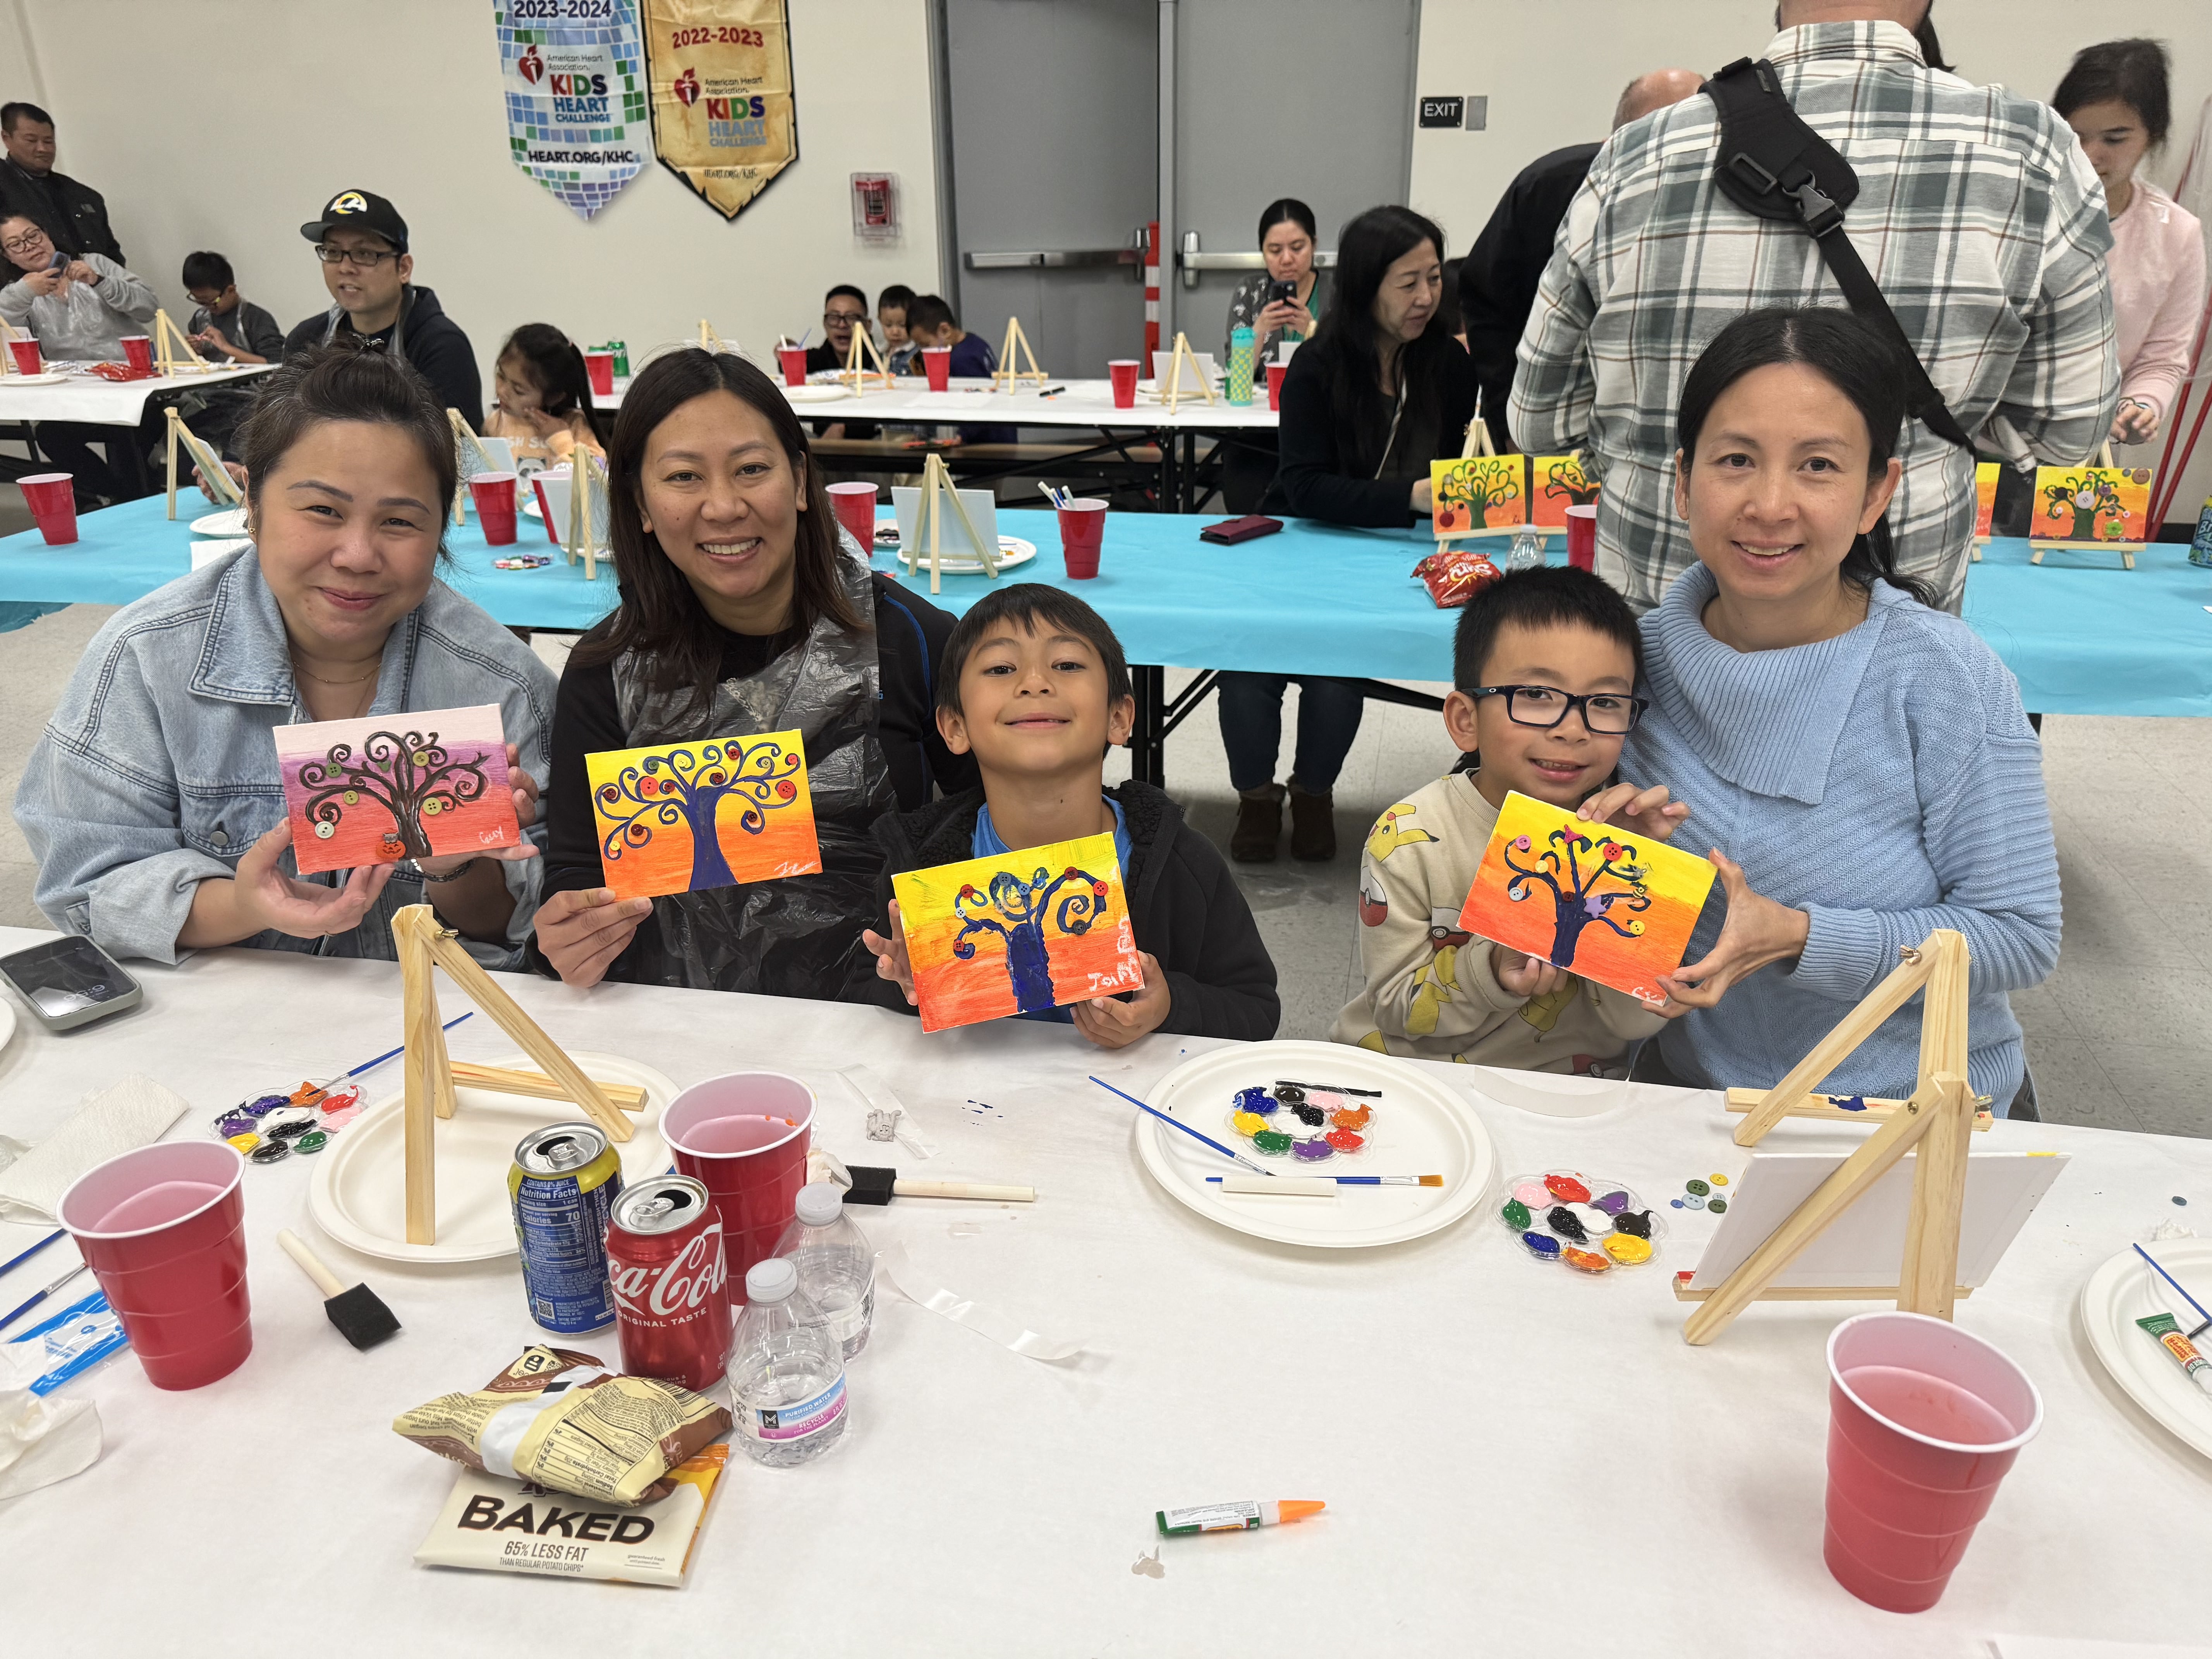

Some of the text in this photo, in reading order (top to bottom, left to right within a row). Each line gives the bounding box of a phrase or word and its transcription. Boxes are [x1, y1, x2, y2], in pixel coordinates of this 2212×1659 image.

[514, 0, 611, 18] 2023-2024
[673, 27, 764, 49] 2022-2023
[547, 54, 580, 62] American
[550, 74, 608, 96] KIDS
[705, 76, 763, 86] American Heart
[553, 97, 609, 112] HEART
[706, 96, 765, 120] KIDS
[1424, 102, 1459, 117] EXIT
[555, 113, 611, 123] CHALLENGE
[708, 119, 765, 137] HEART
[709, 136, 767, 148] CHALLENGE
[528, 151, 634, 165] HEART.ORG/KHC
[64, 984, 105, 1002] 6:56
[527, 1178, 546, 1188] CONTAINS
[520, 1186, 577, 1199] Nutrition Facts
[520, 1197, 536, 1207] Serving
[599, 1184, 610, 1224] ECYCLE
[522, 1211, 580, 1224] Calories 70
[608, 1223, 727, 1316] ca-Col
[618, 1310, 666, 1327] ORIGINAL
[671, 1307, 707, 1326] TASTE
[785, 1392, 831, 1417] PURIFIED WATER
[403, 1414, 418, 1423] began
[466, 1417, 481, 1428] better
[799, 1412, 824, 1429] RECYCLE
[813, 1415, 829, 1429] PLANET
[467, 1425, 477, 1434] with
[570, 1434, 585, 1445] Sugars
[627, 1437, 647, 1452] Potassium
[637, 1435, 651, 1447] Vitamin
[585, 1442, 597, 1451] Added
[564, 1455, 572, 1463] 23g
[596, 1454, 611, 1466] Sugars
[624, 1447, 641, 1460] Calcium
[572, 1460, 604, 1477] Carbohydrate
[591, 1459, 603, 1468] Fiber
[603, 1464, 617, 1475] Dietary
[574, 1477, 584, 1485] 0mg
[581, 1471, 595, 1482] 200mg
[604, 1474, 617, 1483] Total
[584, 1482, 612, 1495] Cholesterol
[595, 1479, 613, 1490] Sodium
[457, 1494, 655, 1545] BAKED
[504, 1540, 589, 1562] 65% LESS FAT
[500, 1557, 515, 1567] THAN
[515, 1559, 542, 1570] REGULAR
[542, 1561, 563, 1571] POTATO
